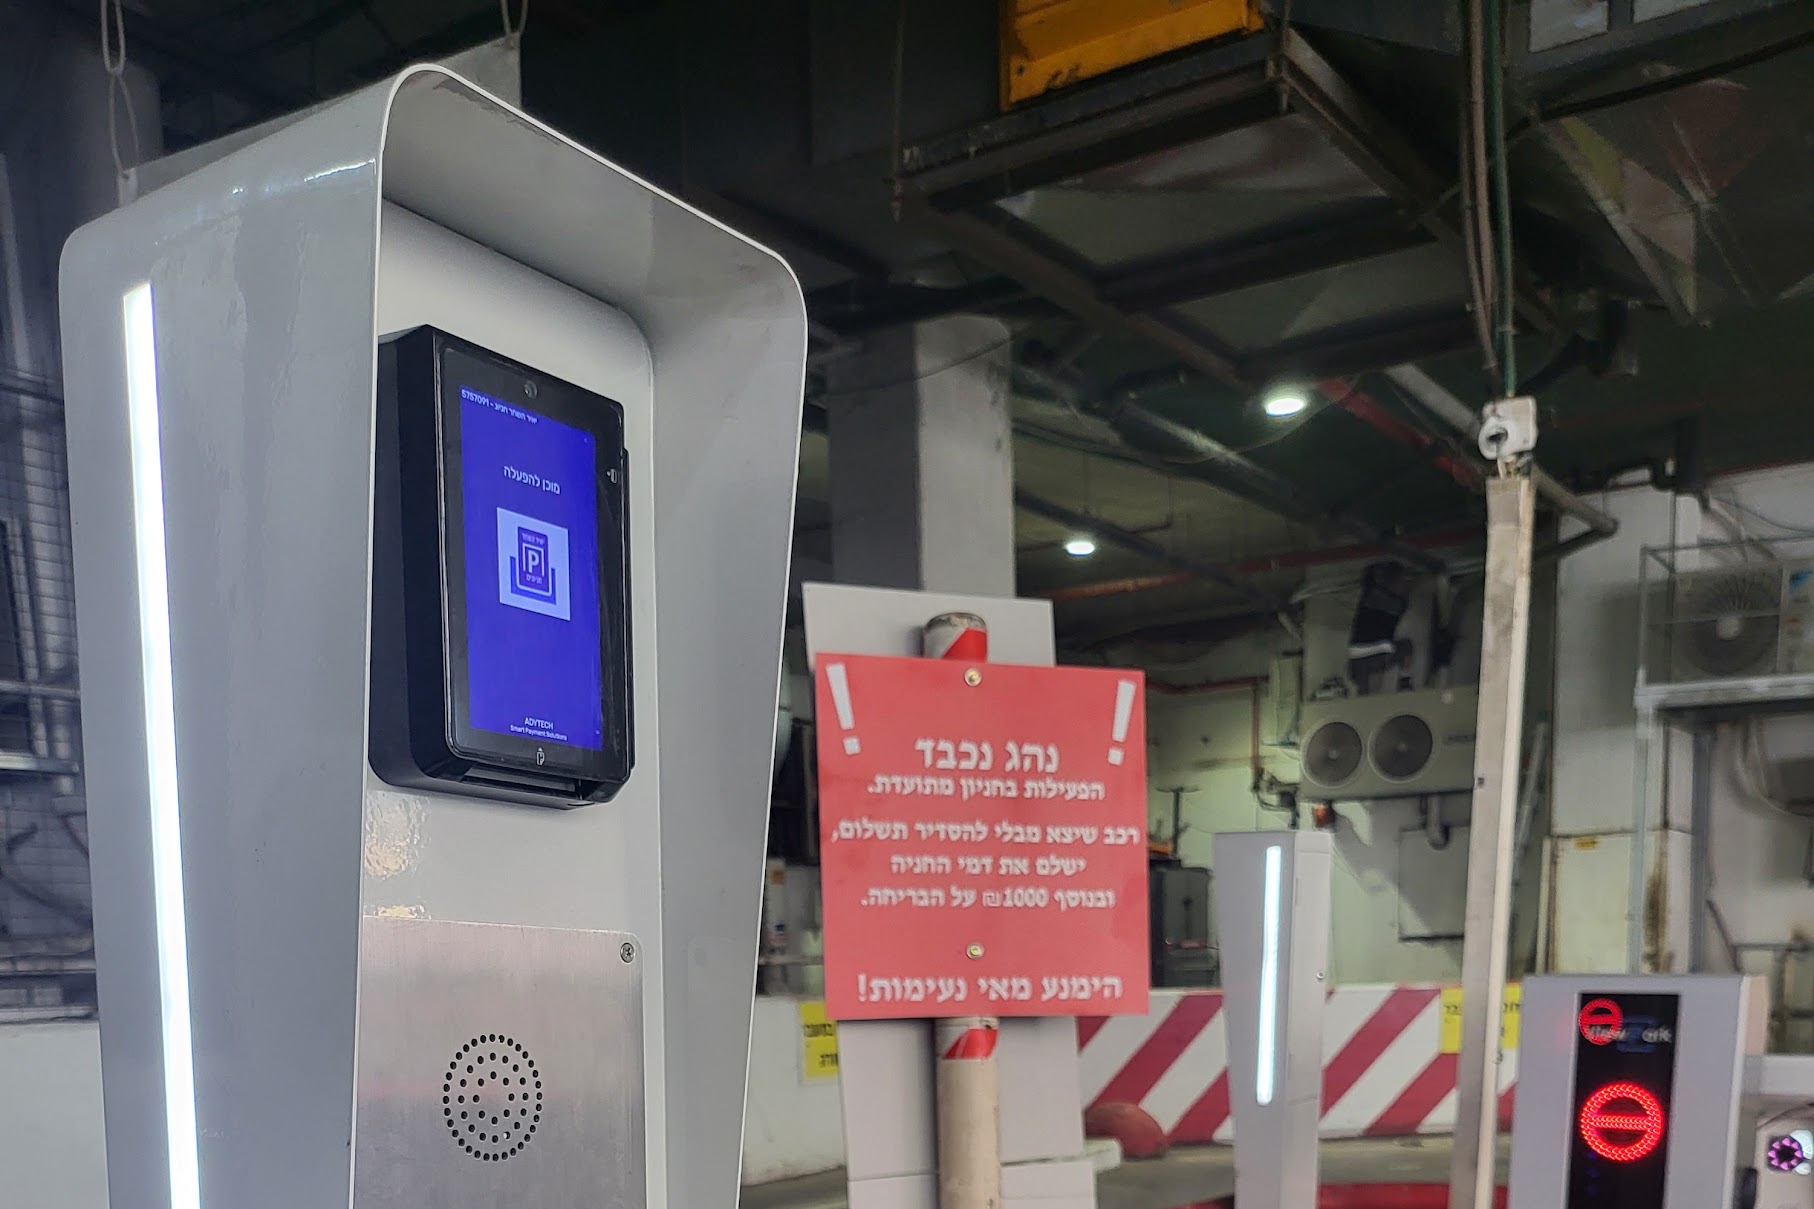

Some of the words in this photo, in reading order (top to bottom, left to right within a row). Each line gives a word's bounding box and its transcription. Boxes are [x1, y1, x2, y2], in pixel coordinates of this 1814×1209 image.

[461, 389, 489, 407] 5757091
[503, 465, 540, 487] להפעלה
[543, 478, 561, 495] מוכן
[527, 549, 540, 573] P
[510, 725, 525, 734] Smart
[525, 727, 546, 738] Payment
[546, 730, 568, 741] Solutions
[524, 717, 554, 730] ADYTECH
[915, 736, 993, 771] נכבד
[1005, 741, 1059, 773] נהג
[868, 774, 954, 796] מתועדת.
[960, 775, 1018, 800] בחניון
[1023, 777, 1105, 800] הפעילות
[832, 817, 908, 843] תשלום,
[914, 820, 988, 842] להסדיר
[995, 820, 1041, 843] מבלי
[1046, 824, 1098, 845] שיצא
[1104, 826, 1140, 845] רכב
[891, 854, 951, 874] החניה
[957, 854, 992, 875] דמי
[999, 855, 1029, 875] את
[1035, 854, 1086, 877] ישלם
[861, 887, 945, 907] הבריחה.
[951, 885, 976, 908] על
[1054, 889, 1115, 911] ובנוסף
[857, 973, 967, 1002] נעימות!
[977, 975, 1032, 1000] מאי
[1041, 974, 1122, 1000] הימנע
